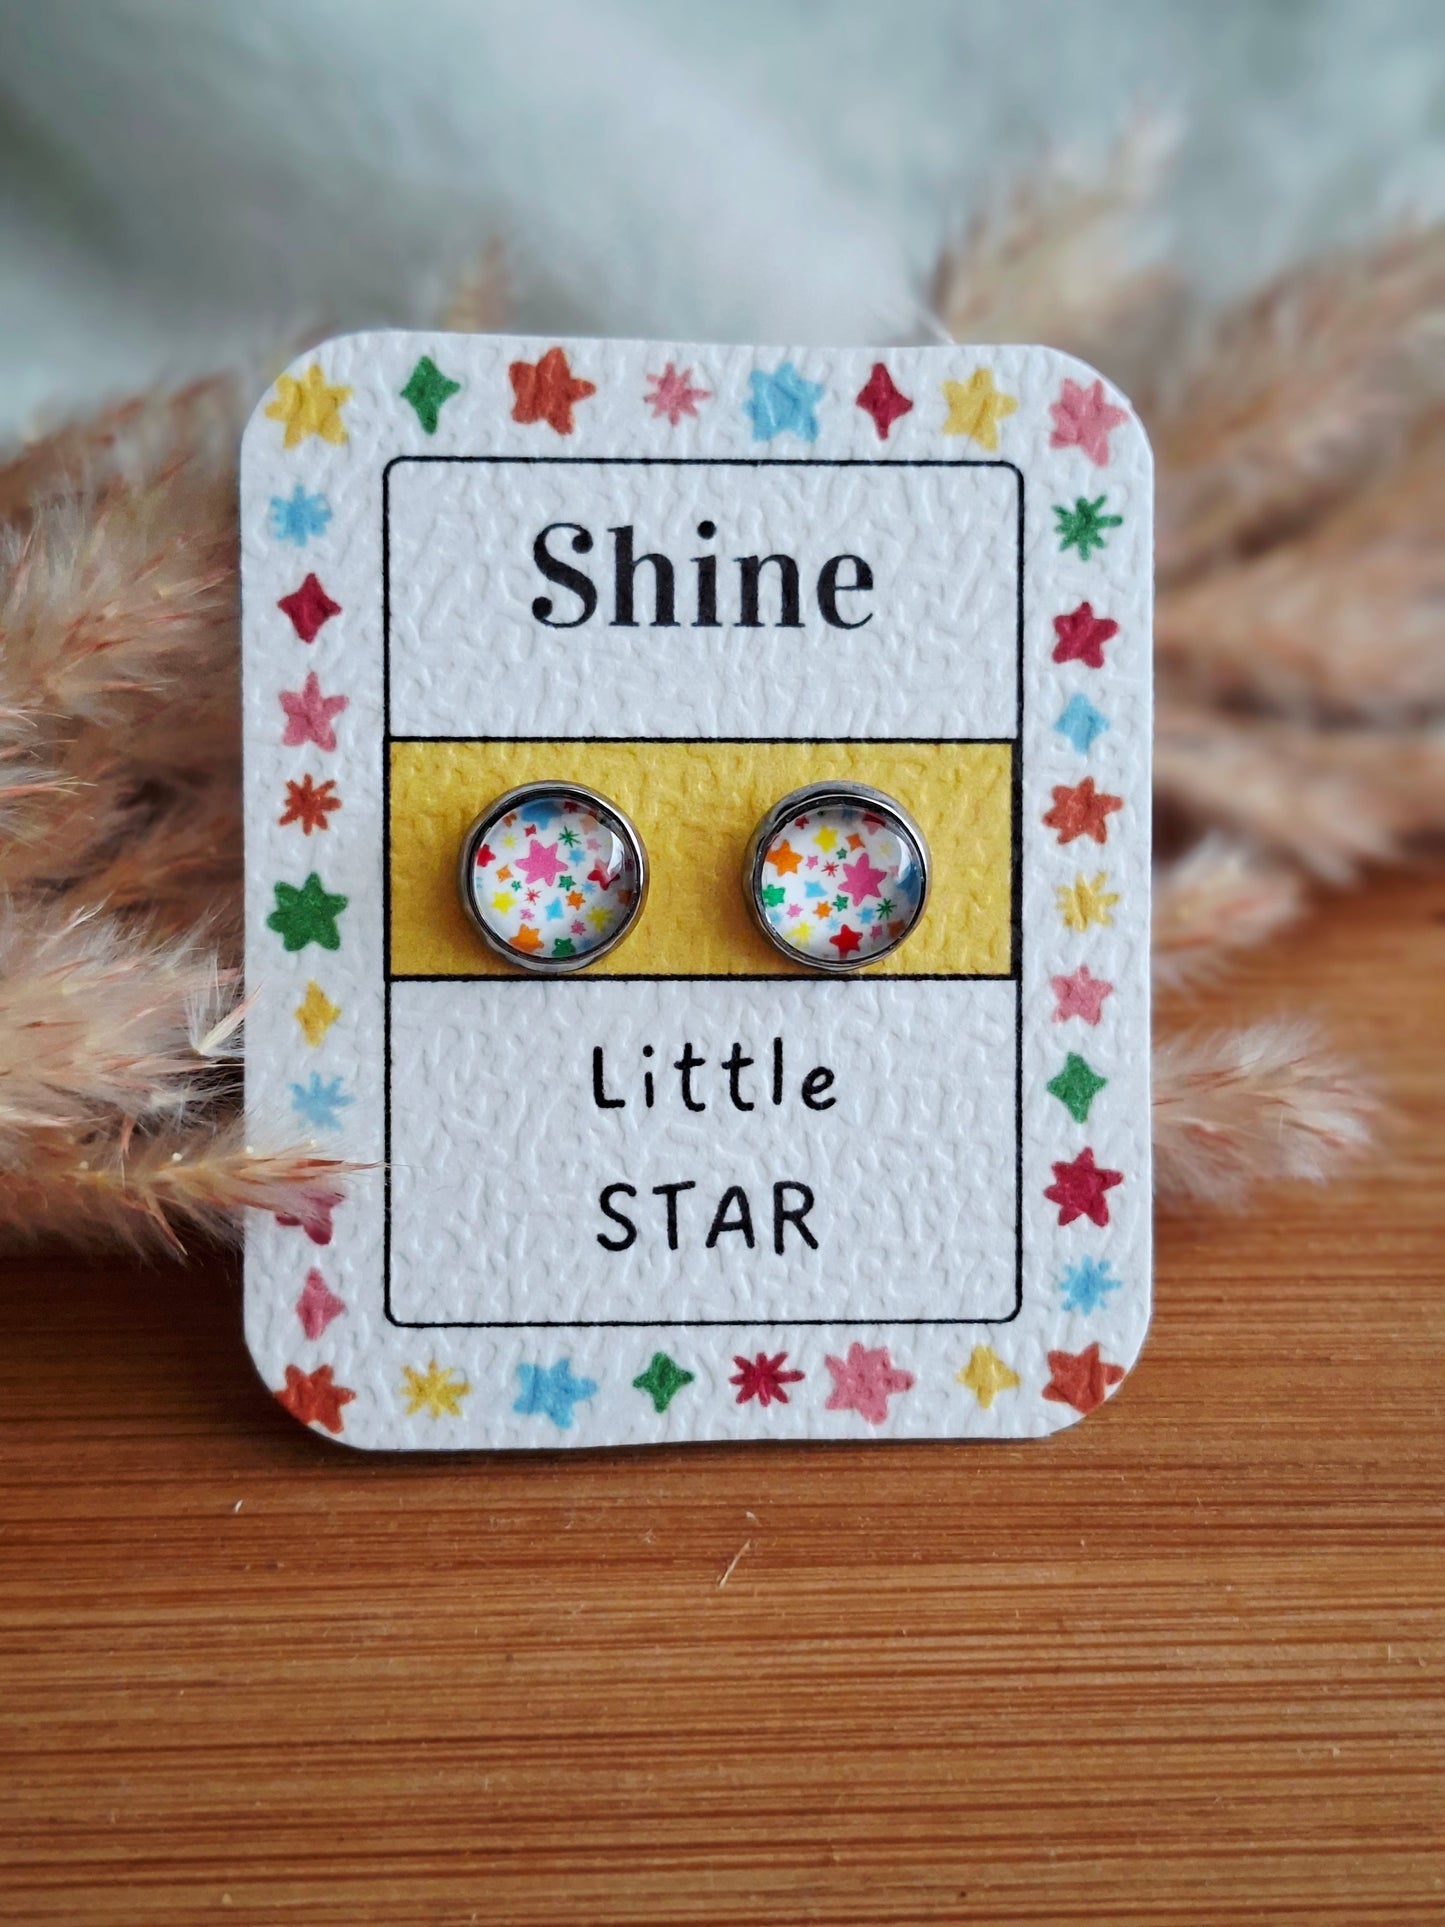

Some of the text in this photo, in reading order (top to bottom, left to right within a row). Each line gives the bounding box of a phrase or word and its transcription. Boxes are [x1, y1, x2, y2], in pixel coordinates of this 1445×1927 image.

[531, 520, 874, 630] Shine
[592, 1036, 838, 1112] Little
[596, 1180, 819, 1255] STAR
